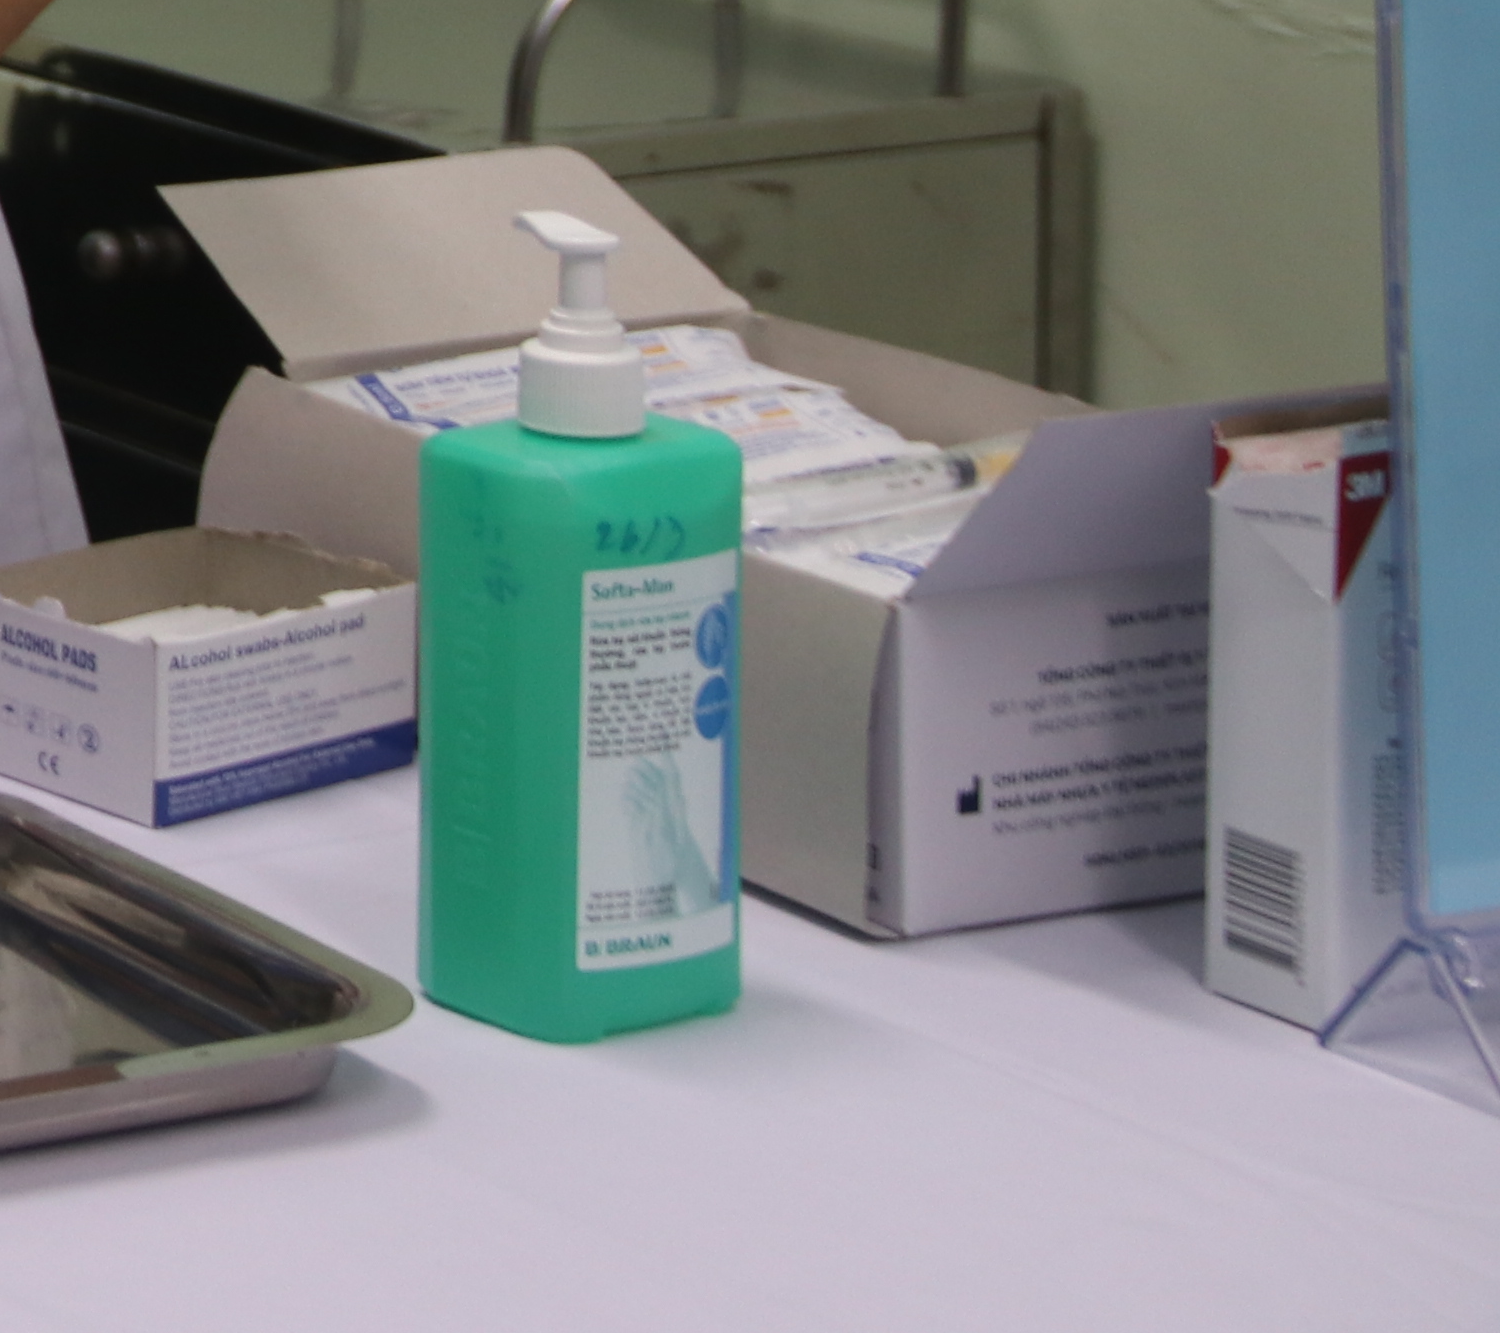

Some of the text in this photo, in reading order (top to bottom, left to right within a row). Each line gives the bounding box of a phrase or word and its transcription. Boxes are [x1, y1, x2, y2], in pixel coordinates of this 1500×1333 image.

[1345, 469, 1387, 502] 3M
[339, 614, 365, 636] pad
[0, 622, 97, 673] ALCOHOL PADS
